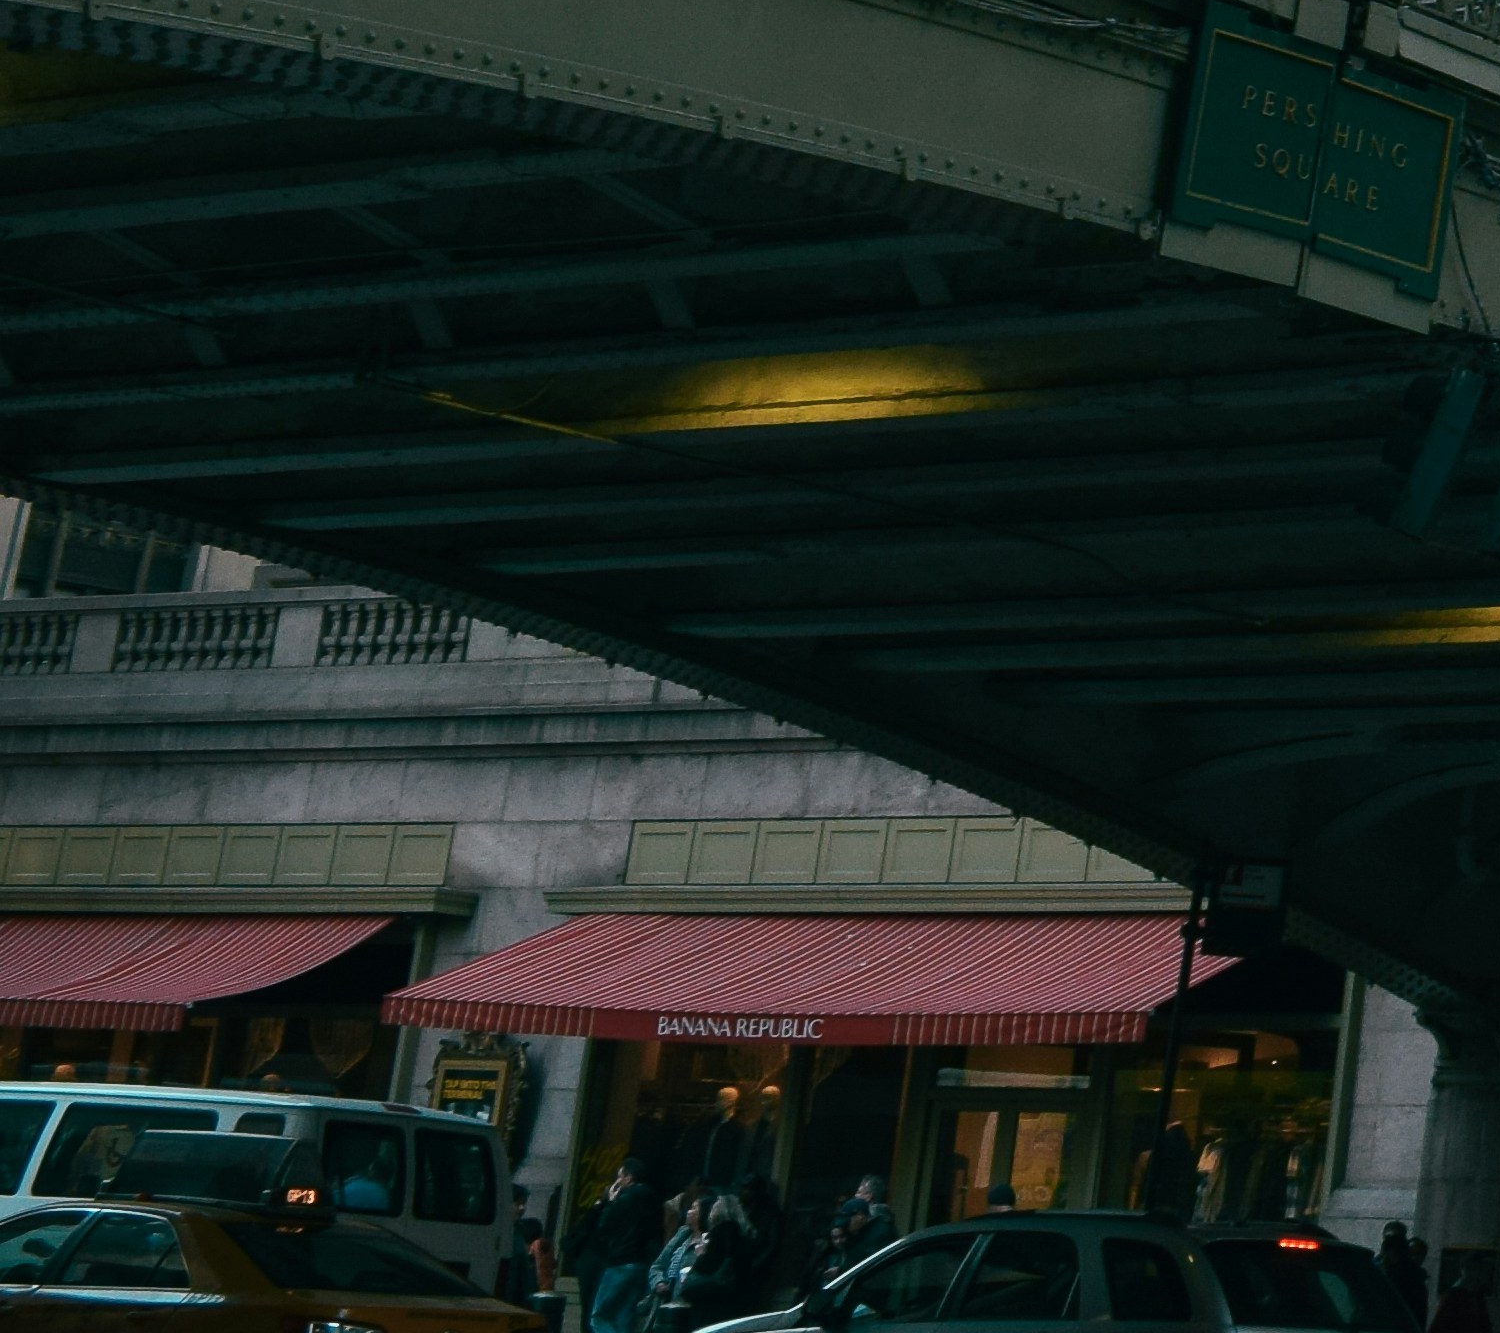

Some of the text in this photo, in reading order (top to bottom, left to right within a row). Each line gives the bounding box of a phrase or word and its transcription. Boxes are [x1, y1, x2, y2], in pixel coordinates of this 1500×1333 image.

[1241, 84, 1409, 169] PERSHING
[1254, 143, 1380, 211] SQUARE
[657, 1016, 824, 1039] BANANA REPUBLIC
